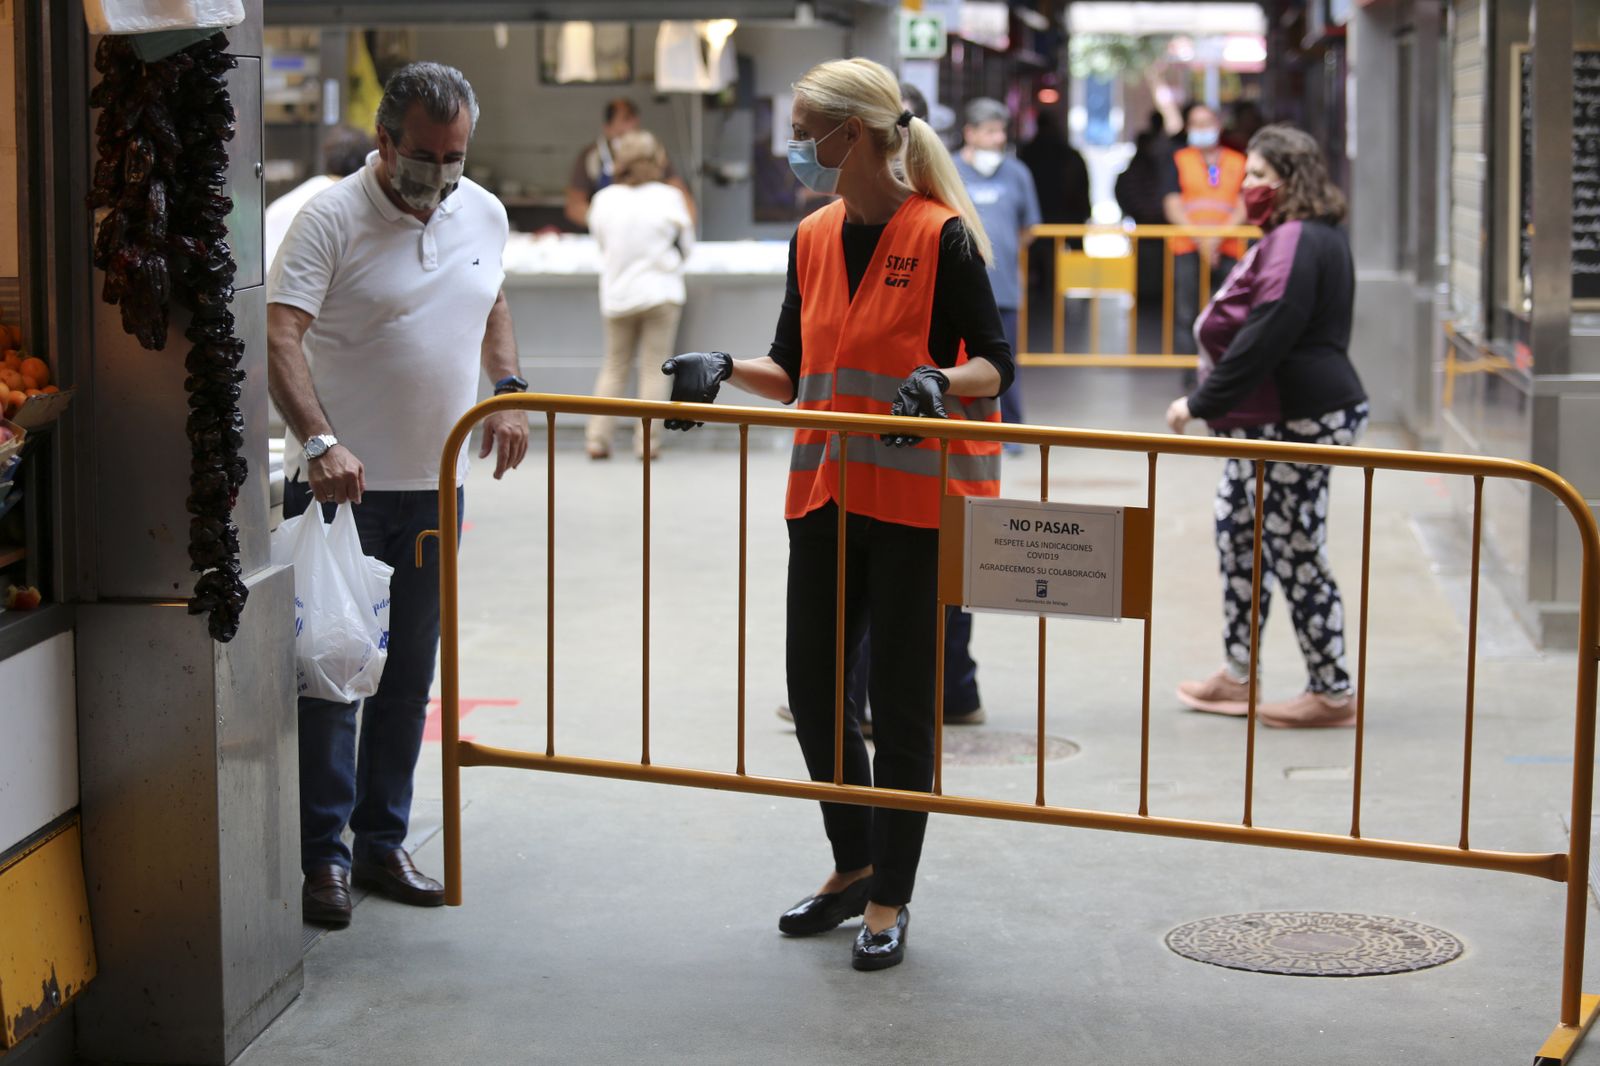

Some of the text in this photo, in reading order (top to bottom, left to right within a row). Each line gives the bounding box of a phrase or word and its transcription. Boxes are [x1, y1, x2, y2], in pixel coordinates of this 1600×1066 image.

[886, 255, 919, 271] STAFF
[1034, 520, 1085, 536] PASAR-
[994, 537, 1093, 552] RESPETE LAS INDICACIONES
[1027, 551, 1059, 561] COVID19
[979, 562, 1107, 580] AGRADECEMOS SU COLABORACIÓN
